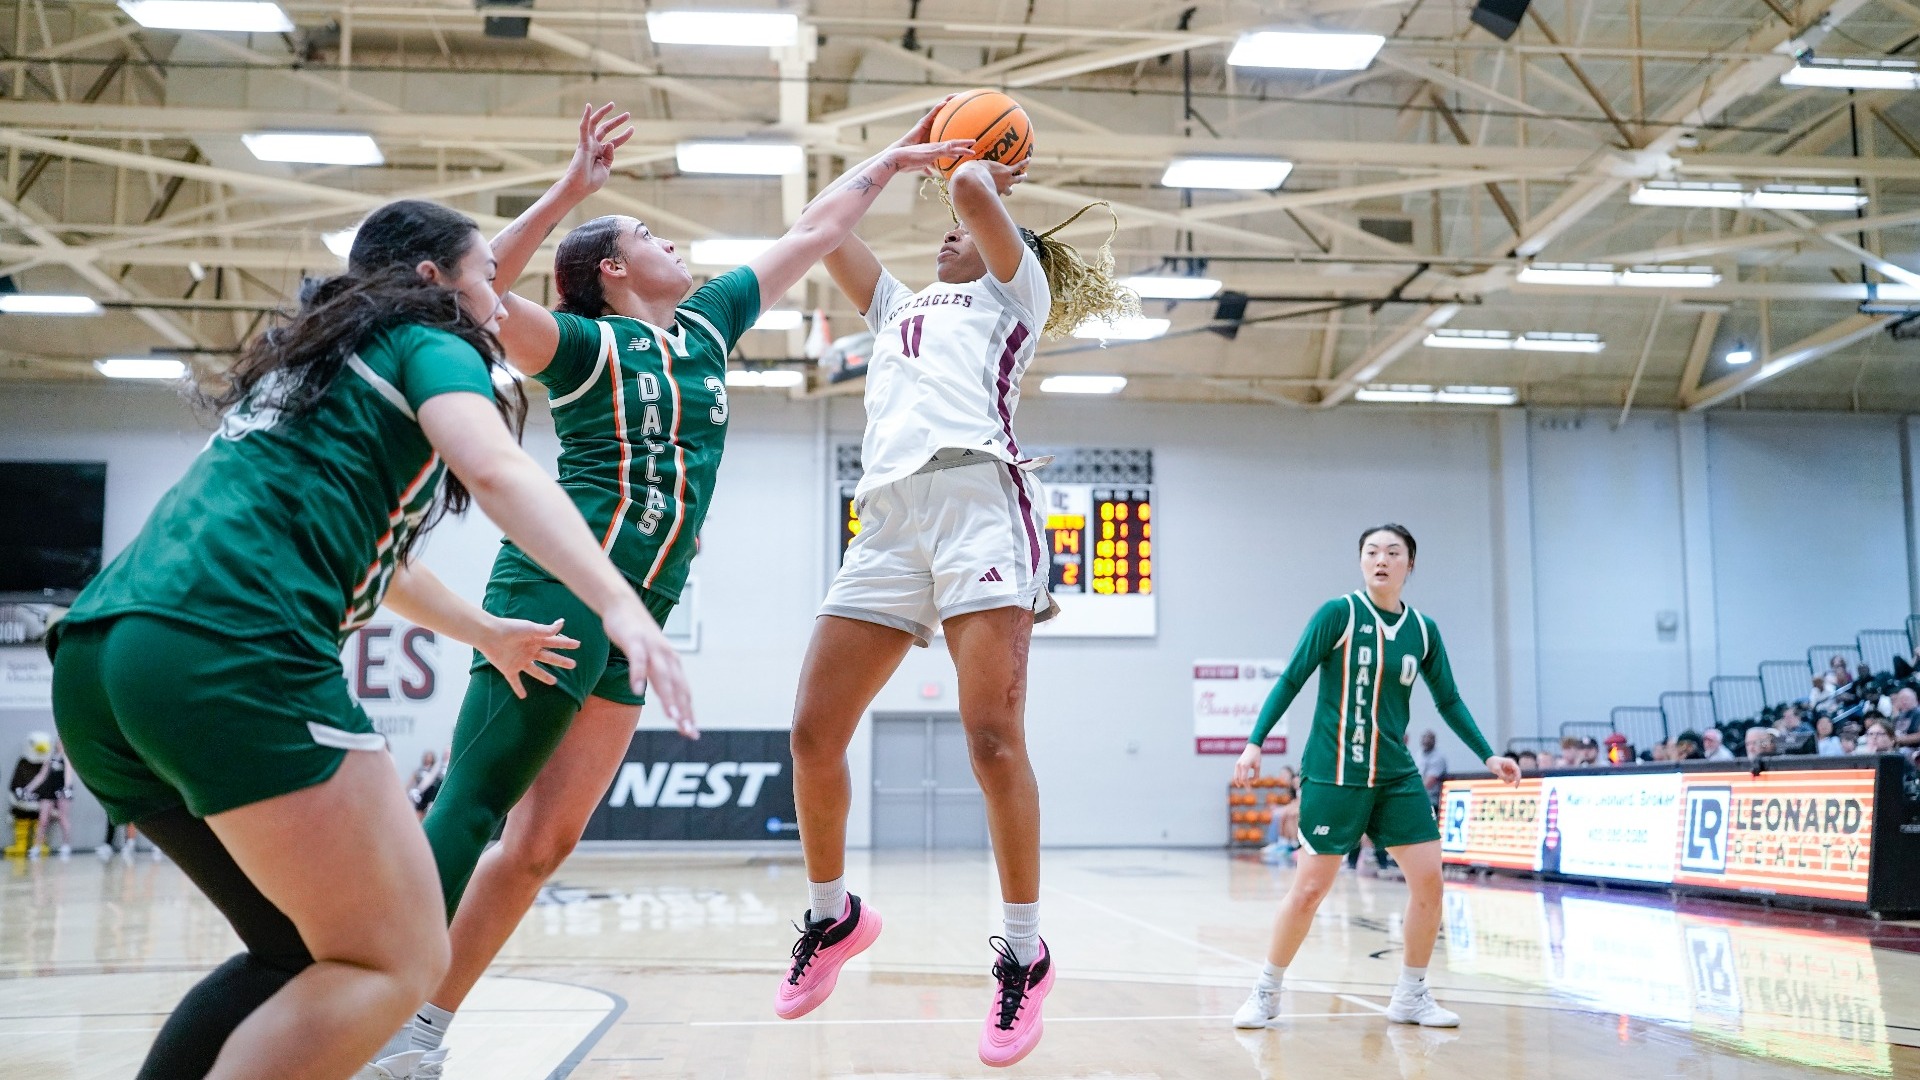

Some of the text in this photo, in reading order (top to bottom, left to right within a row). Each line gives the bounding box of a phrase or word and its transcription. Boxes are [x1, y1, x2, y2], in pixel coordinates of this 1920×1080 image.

[912, 293, 973, 309] EAGLES
[899, 314, 925, 358] 11
[703, 376, 728, 425] 3
[636, 371, 667, 536] DALLAS
[1351, 645, 1373, 764] DALLAS
[608, 762, 782, 808] NEST
[1312, 824, 1331, 836] NB
[1736, 798, 1862, 834] LEONARD
[1734, 840, 1859, 871] REALTY
